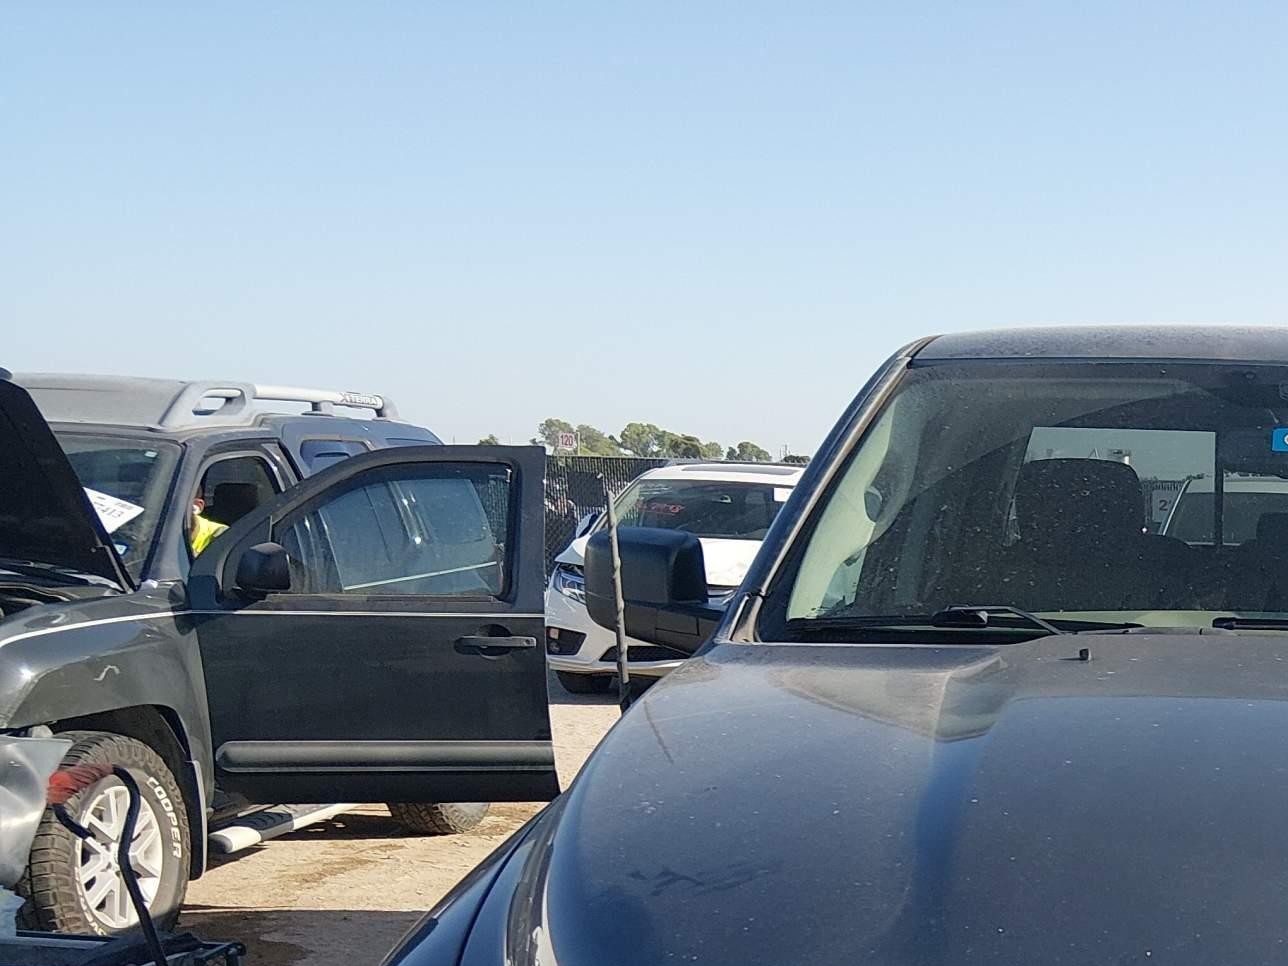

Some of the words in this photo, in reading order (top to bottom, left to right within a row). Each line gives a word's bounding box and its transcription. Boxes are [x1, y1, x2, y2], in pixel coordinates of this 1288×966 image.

[339, 391, 378, 406] XTERRA
[560, 434, 574, 447] 120
[146, 776, 182, 858] COOPER
